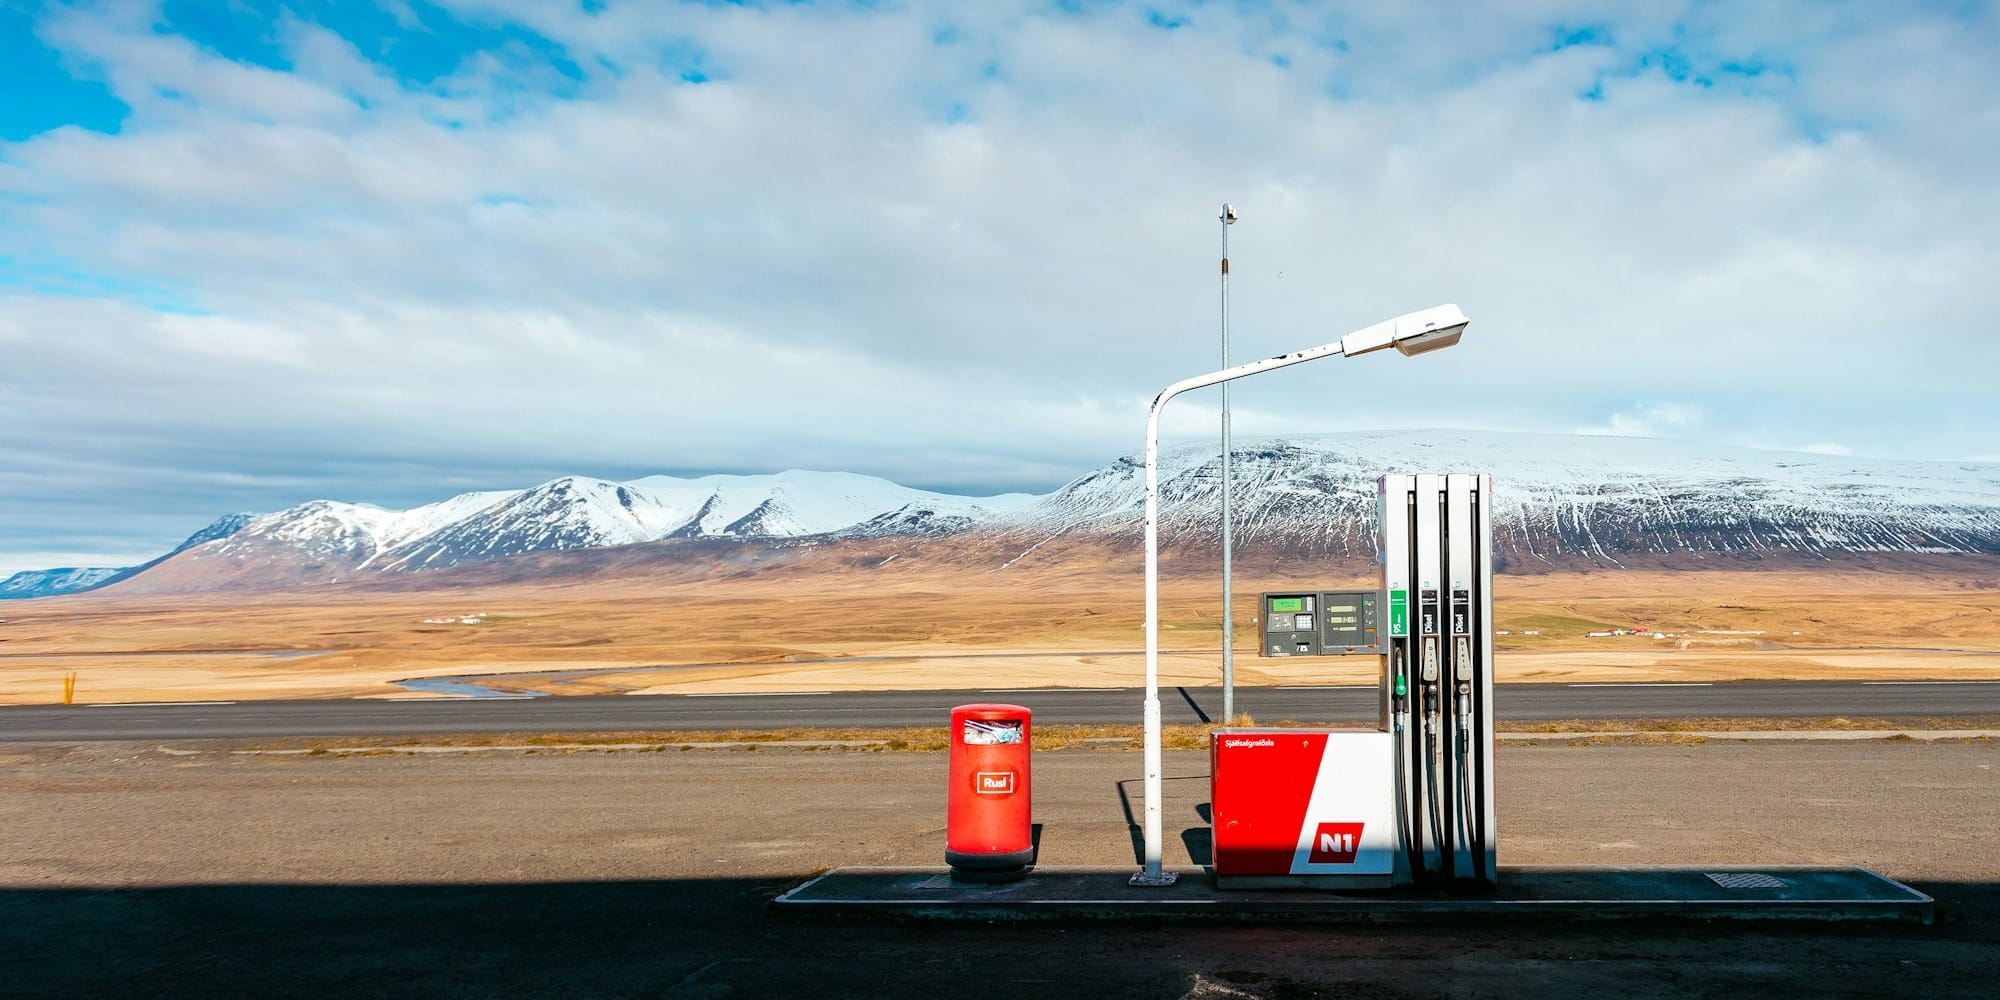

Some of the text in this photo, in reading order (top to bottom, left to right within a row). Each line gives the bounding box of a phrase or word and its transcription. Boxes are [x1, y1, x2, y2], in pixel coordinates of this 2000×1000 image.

[1393, 623, 1401, 633] 95
[983, 777, 1007, 788] Rusl
[1320, 833, 1353, 853] N1
